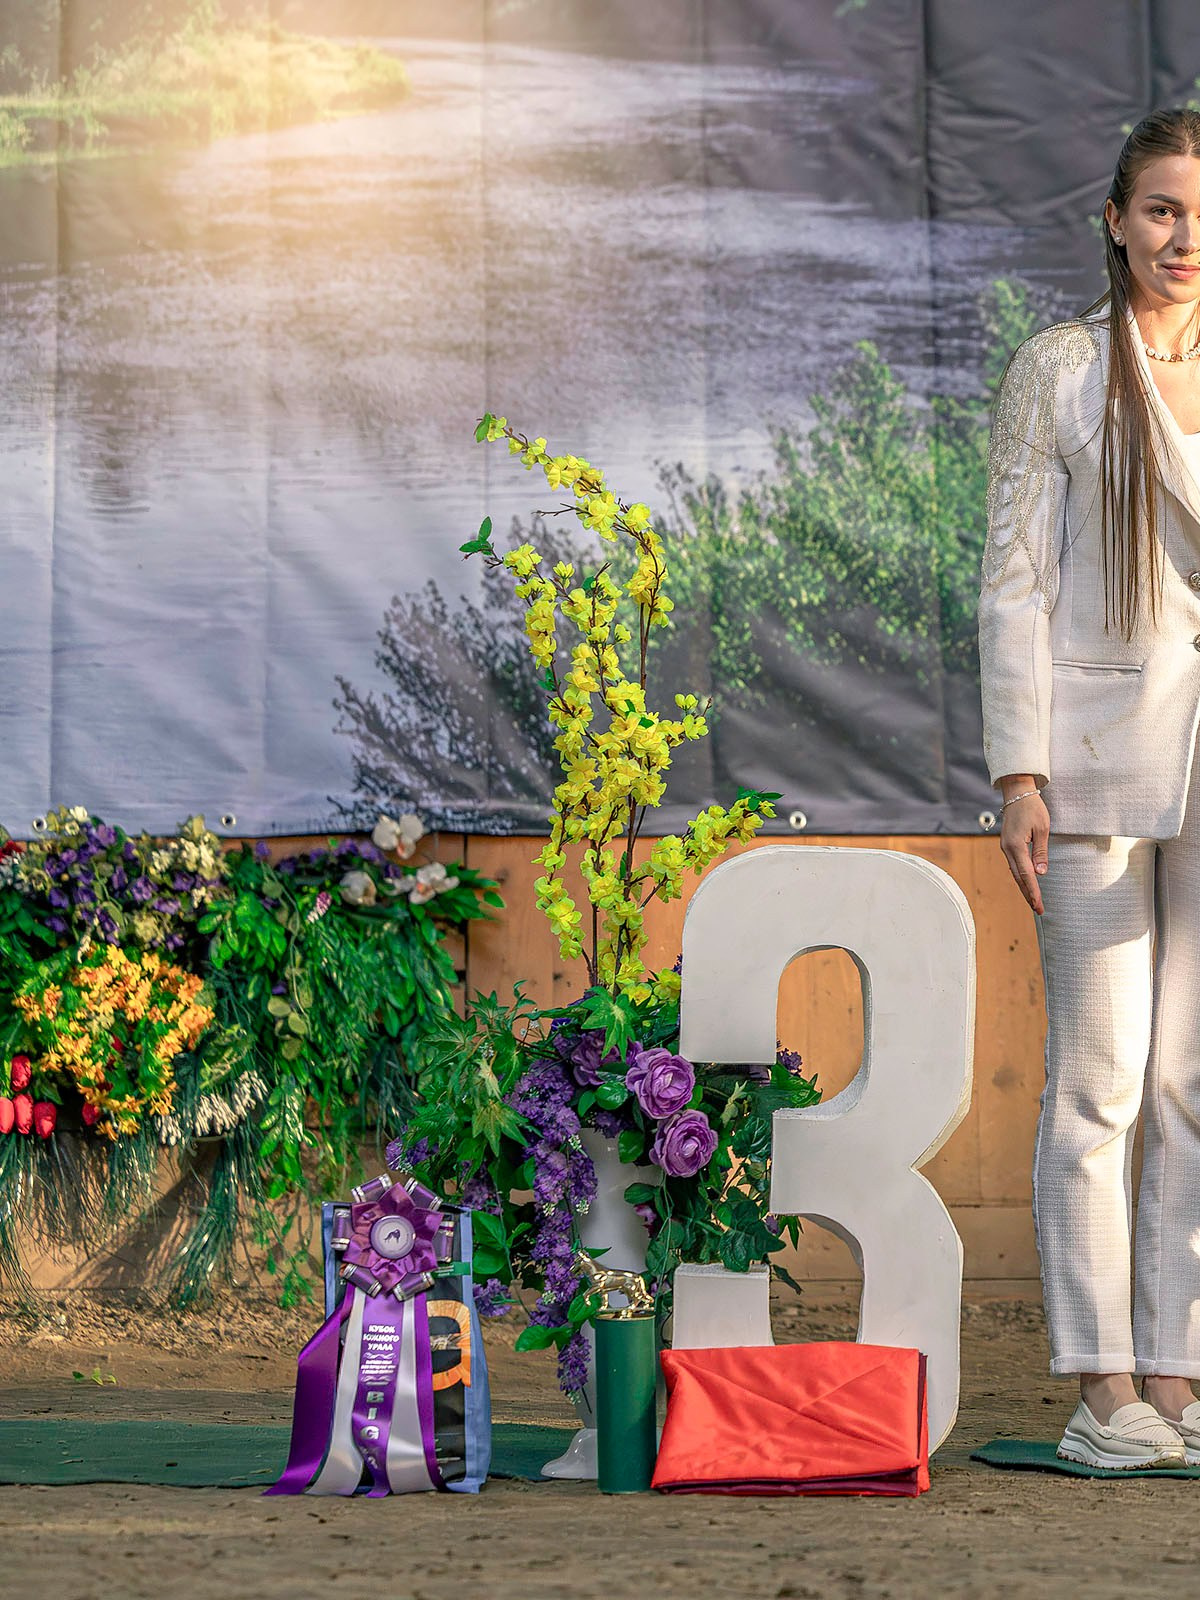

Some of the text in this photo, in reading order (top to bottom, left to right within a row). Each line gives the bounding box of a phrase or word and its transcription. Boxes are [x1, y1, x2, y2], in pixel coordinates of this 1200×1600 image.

[672, 844, 977, 1458] 3
[368, 1325, 396, 1333] КУБОК
[362, 1333, 400, 1342] ЮЖНОГО
[367, 1342, 394, 1351] УРАЛА
